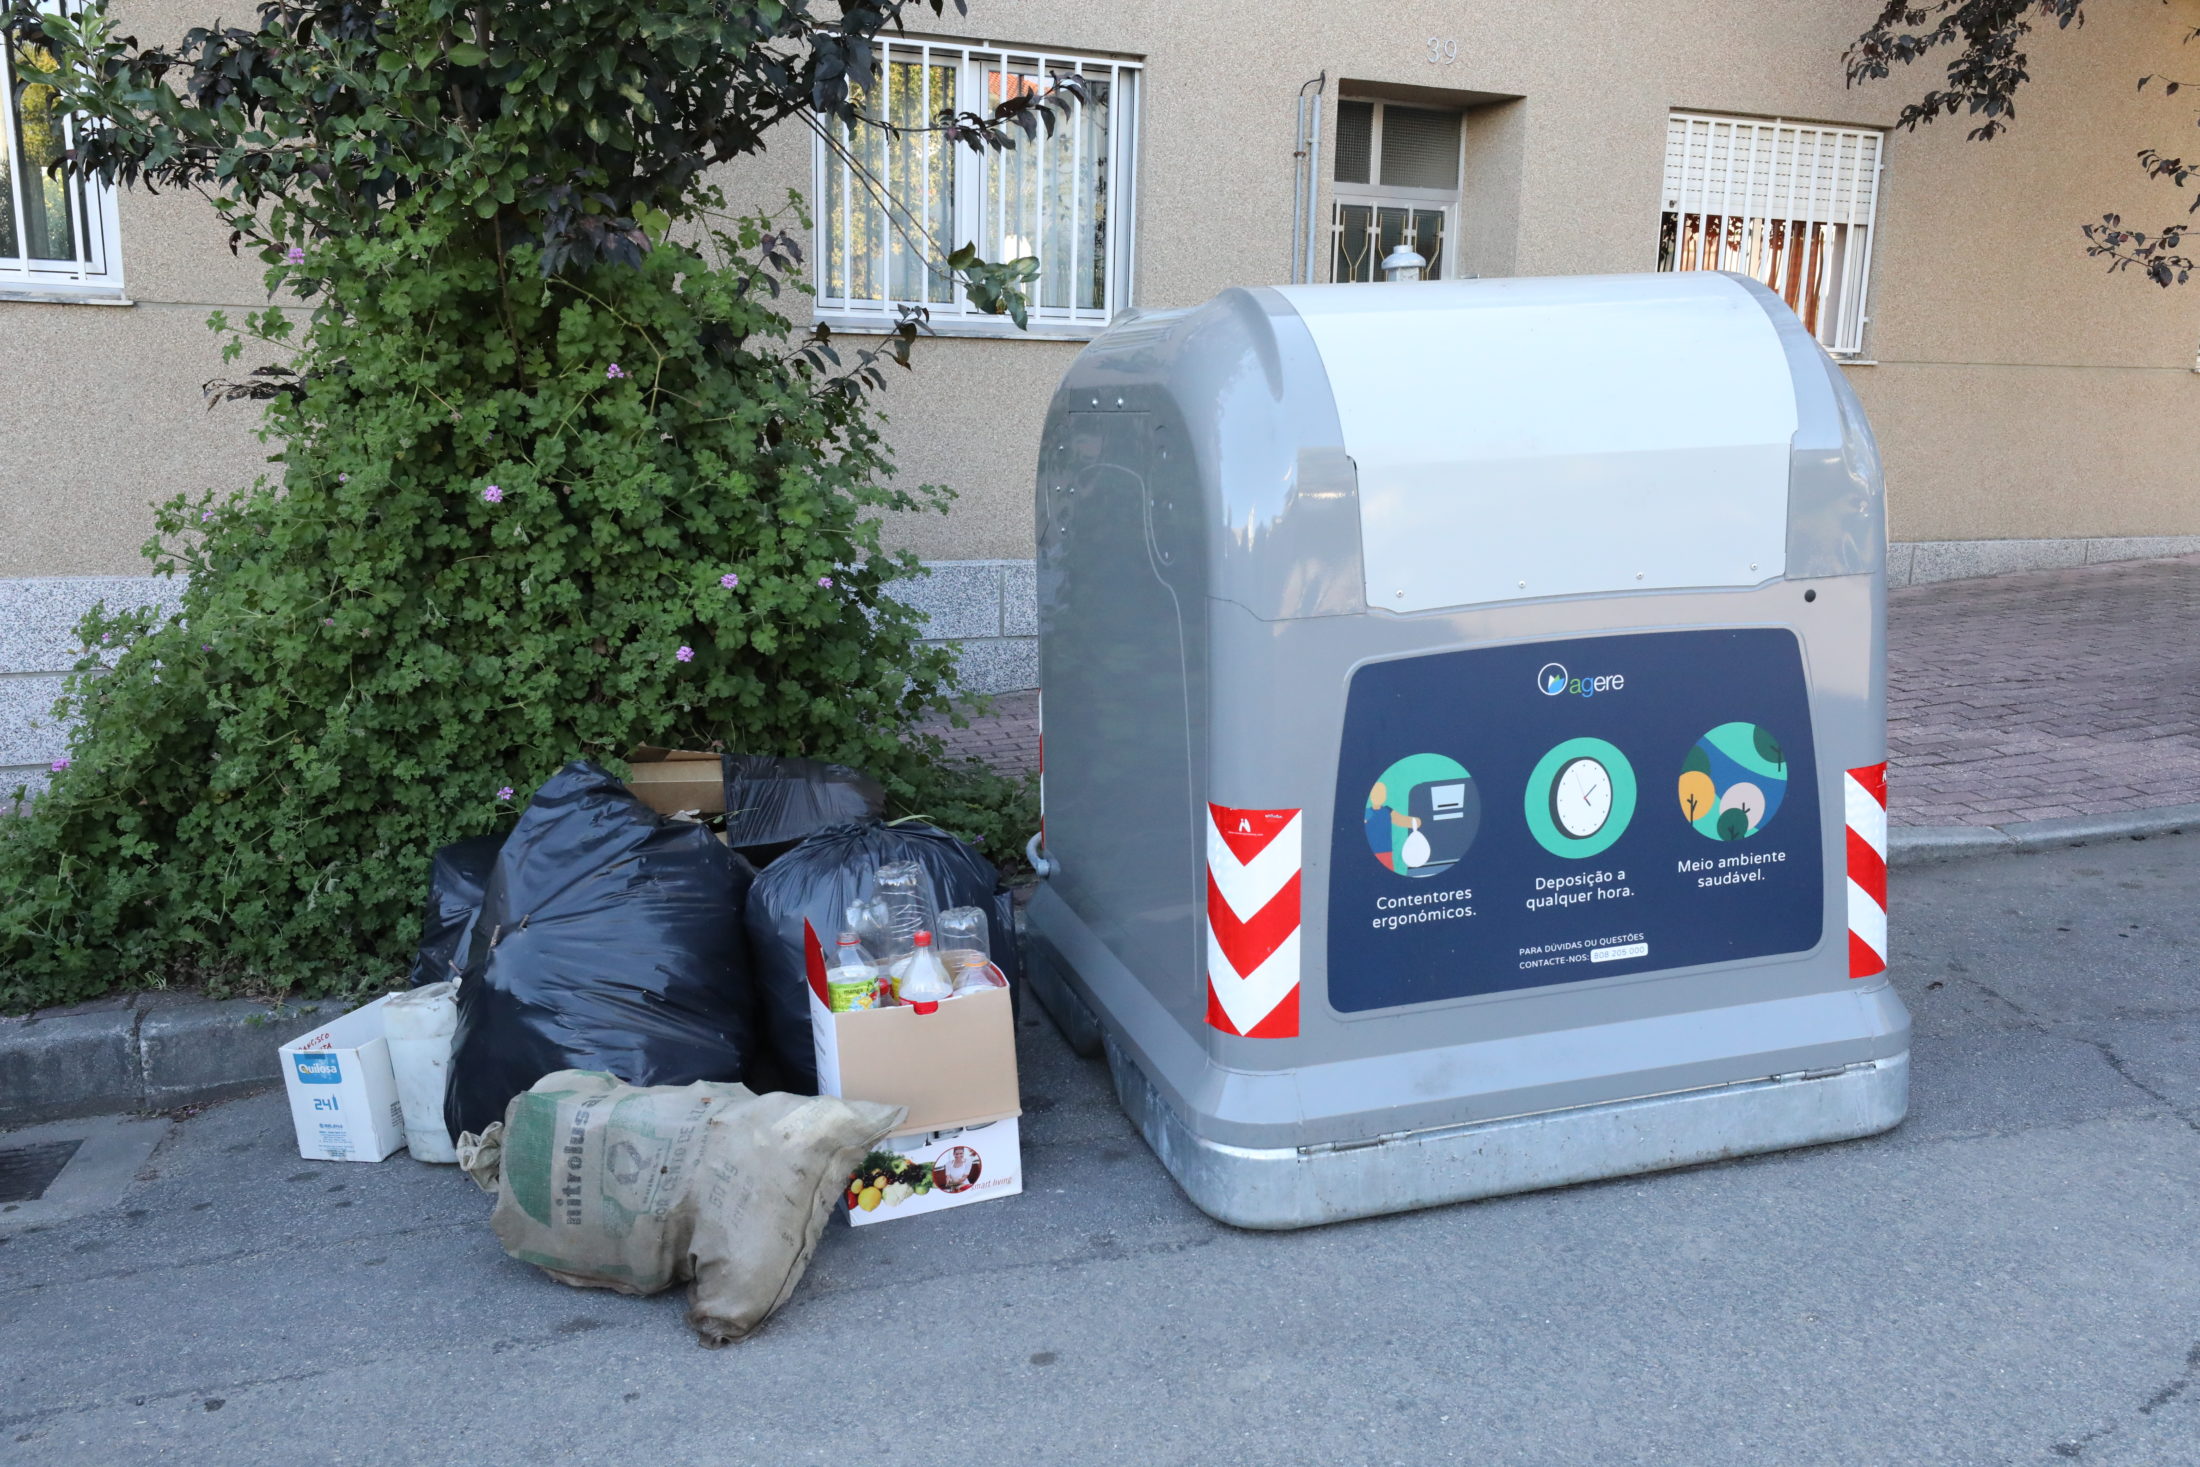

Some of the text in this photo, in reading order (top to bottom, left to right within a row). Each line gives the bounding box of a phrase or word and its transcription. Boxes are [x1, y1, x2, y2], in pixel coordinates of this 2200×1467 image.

[1426, 37, 1457, 65] 39
[1569, 674, 1624, 698] agere
[1677, 851, 1786, 873] Meio ambiente
[1535, 870, 1626, 891] Deposição a
[1697, 868, 1766, 888] saudável.
[1376, 888, 1473, 910] Contentores
[1526, 887, 1635, 912] qualquer hora.
[1372, 906, 1477, 930] ergonómicos.
[1519, 946, 1543, 956] PARA
[1544, 940, 1583, 953] DÚVIDAS
[1584, 938, 1598, 948] OU
[1519, 946, 1645, 970] CONTACTE-NOS: 808 205 000
[298, 1063, 338, 1075] Quilosa
